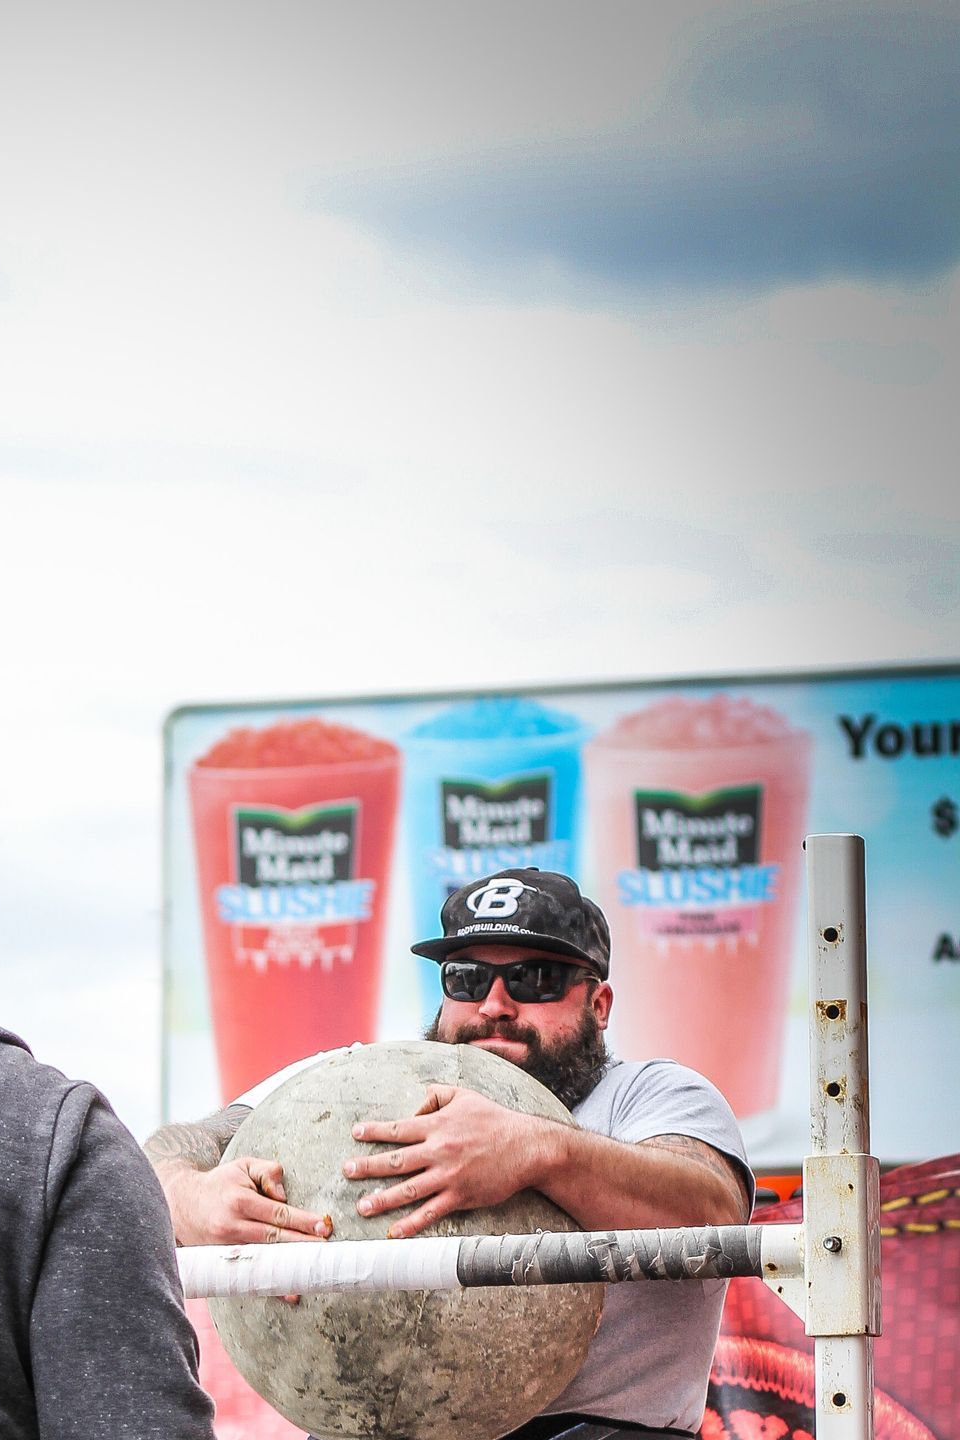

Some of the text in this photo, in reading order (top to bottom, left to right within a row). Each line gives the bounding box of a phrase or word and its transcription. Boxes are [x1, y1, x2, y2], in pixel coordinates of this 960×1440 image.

[447, 795, 544, 822] Minute
[459, 820, 531, 844] Maid
[643, 809, 752, 838] Minute
[243, 827, 348, 856] Minute
[657, 834, 738, 864] Maid
[257, 852, 334, 881] Maid
[218, 880, 375, 922] SLUSHIE
[618, 866, 780, 907] SLUSHIE
